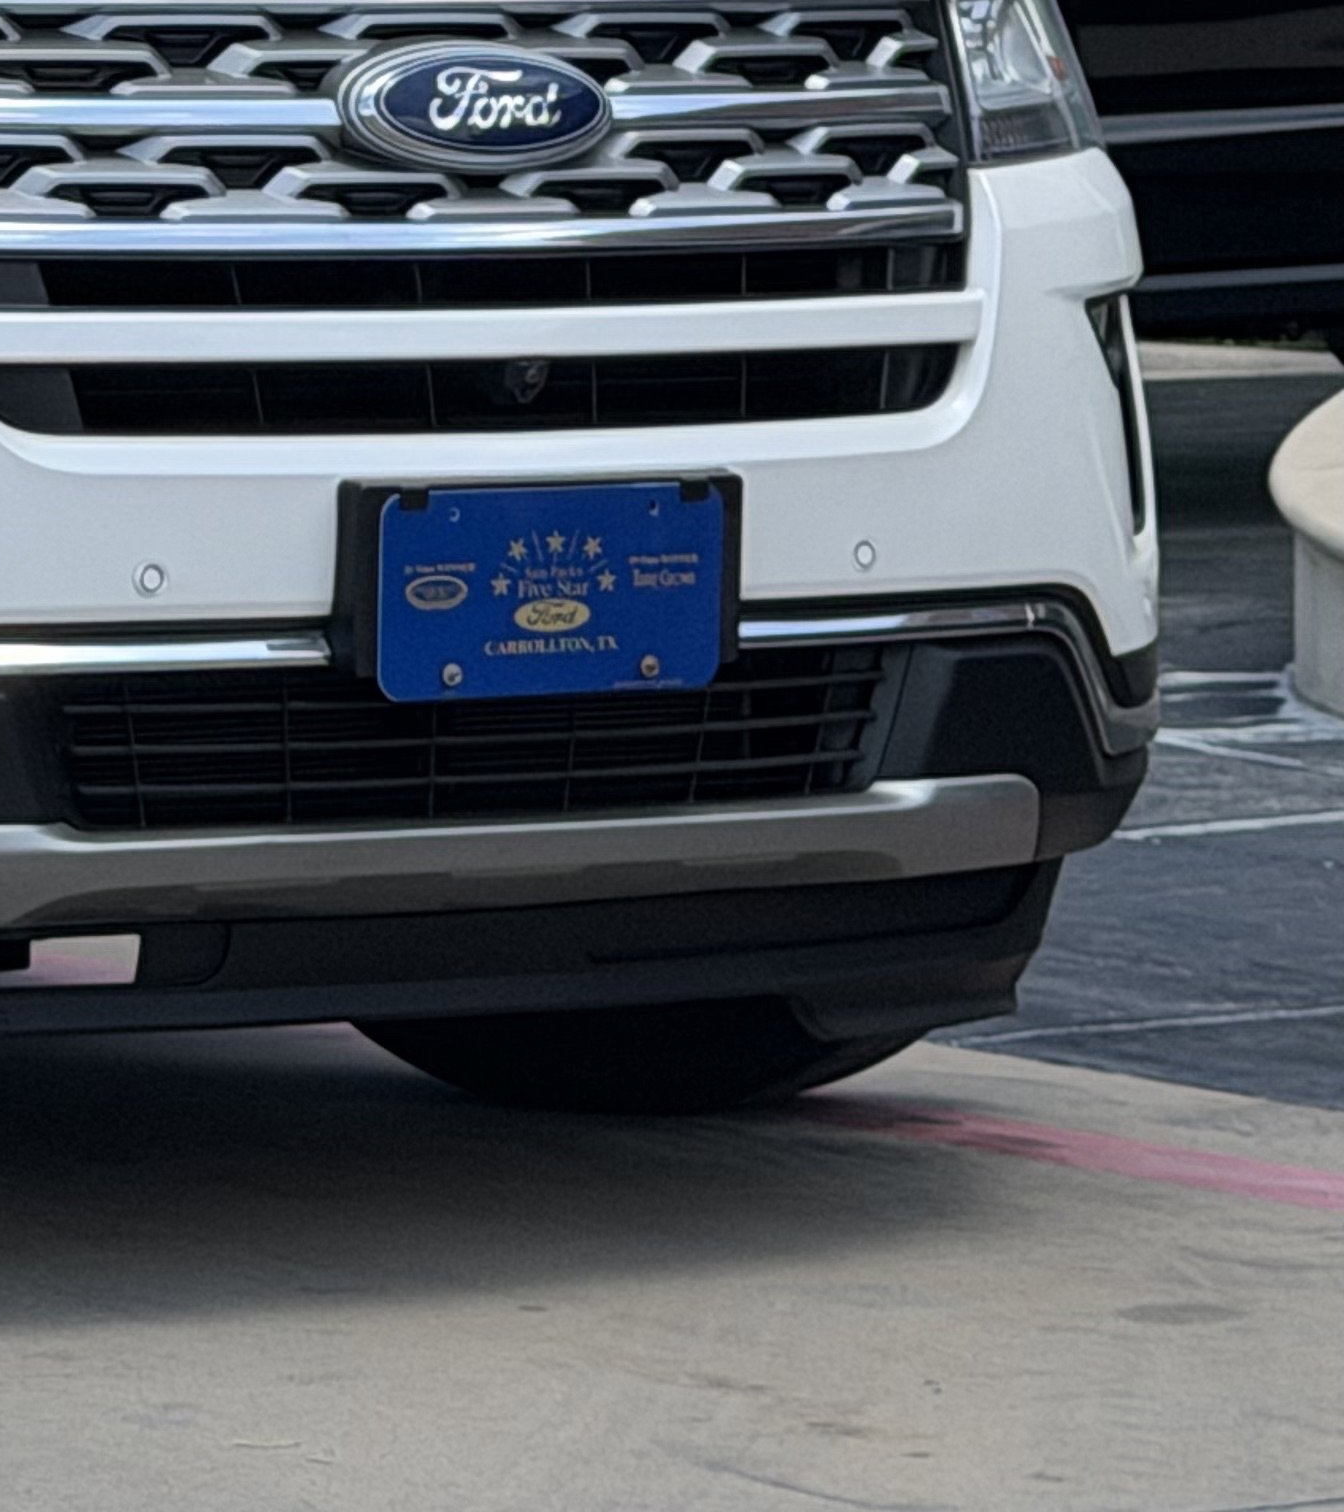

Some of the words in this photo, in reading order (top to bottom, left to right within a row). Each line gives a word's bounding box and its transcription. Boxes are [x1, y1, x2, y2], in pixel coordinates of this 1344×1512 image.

[429, 66, 560, 130] Ford
[520, 580, 551, 597] Five
[559, 579, 588, 596] Star
[527, 603, 578, 625] Ford
